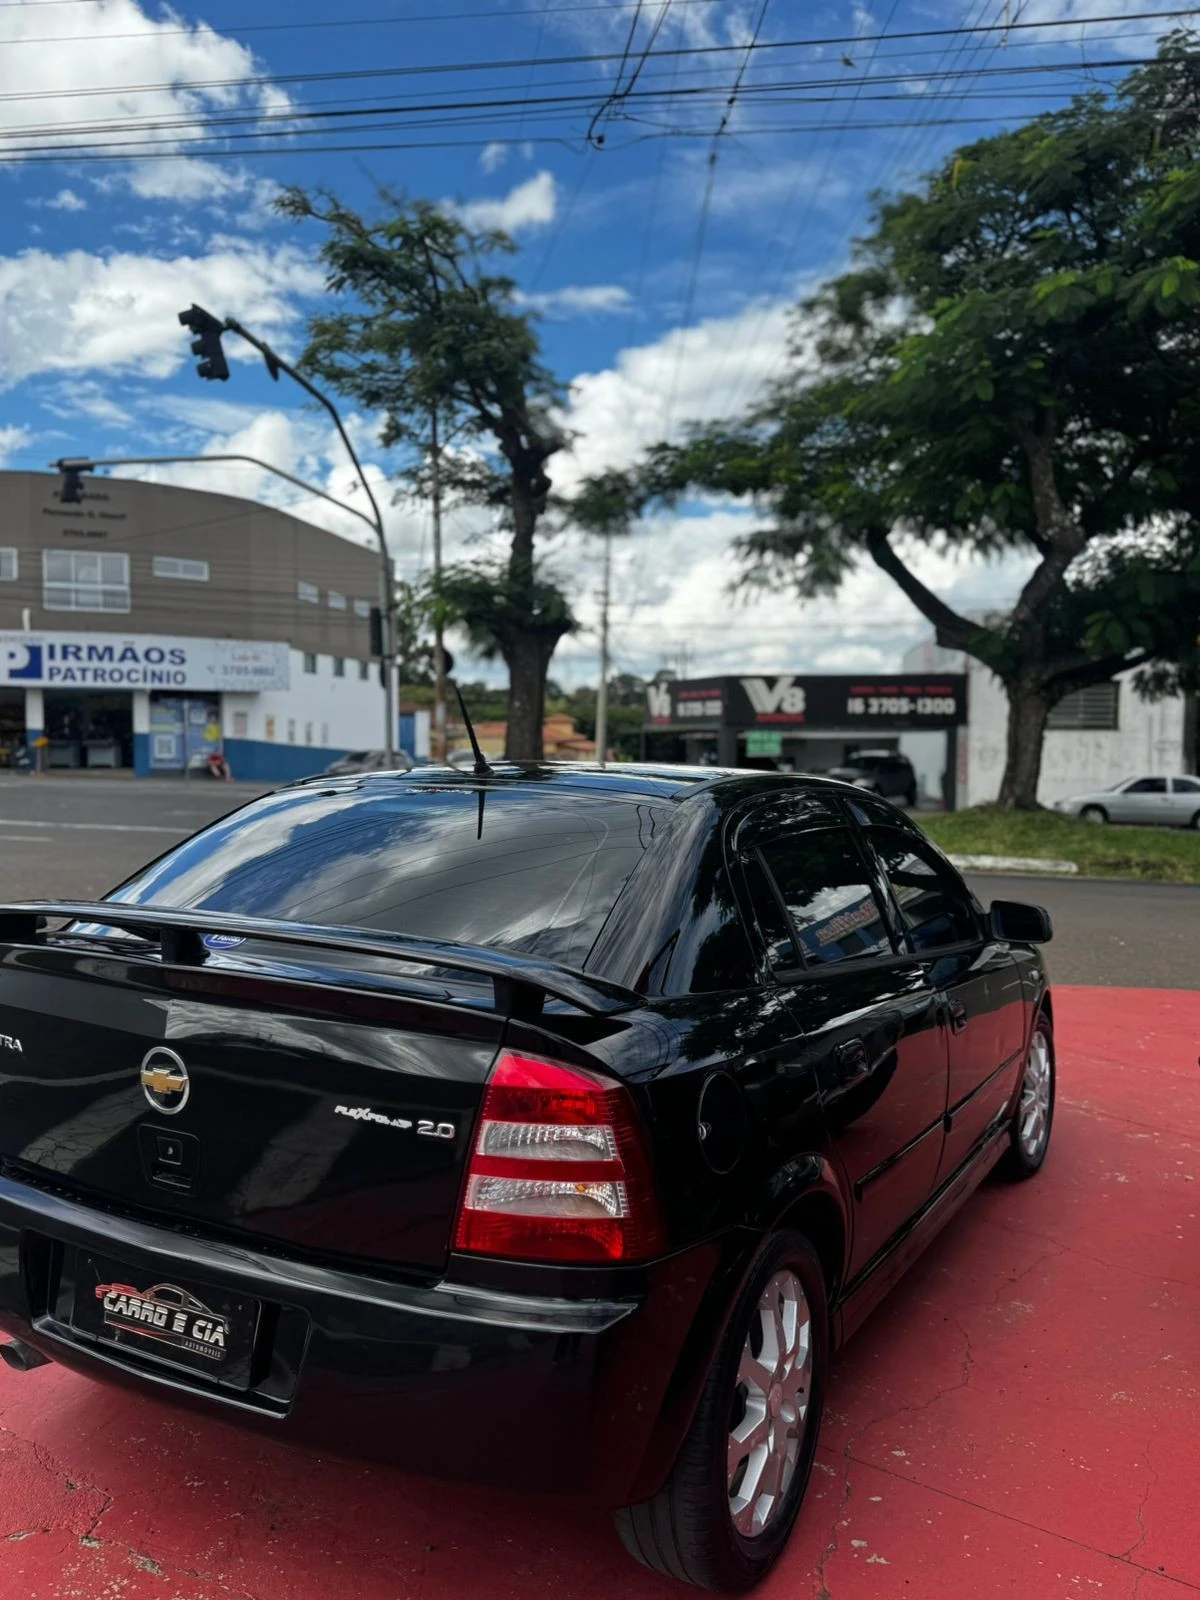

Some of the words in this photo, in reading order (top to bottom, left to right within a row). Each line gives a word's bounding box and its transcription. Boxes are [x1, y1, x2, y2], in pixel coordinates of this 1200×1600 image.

[47, 641, 187, 666] IRMÃOS
[48, 666, 187, 685] PATROCÍNIO
[103, 1291, 169, 1327] CARRO
[172, 1312, 188, 1333] E
[192, 1319, 225, 1347] CIA
